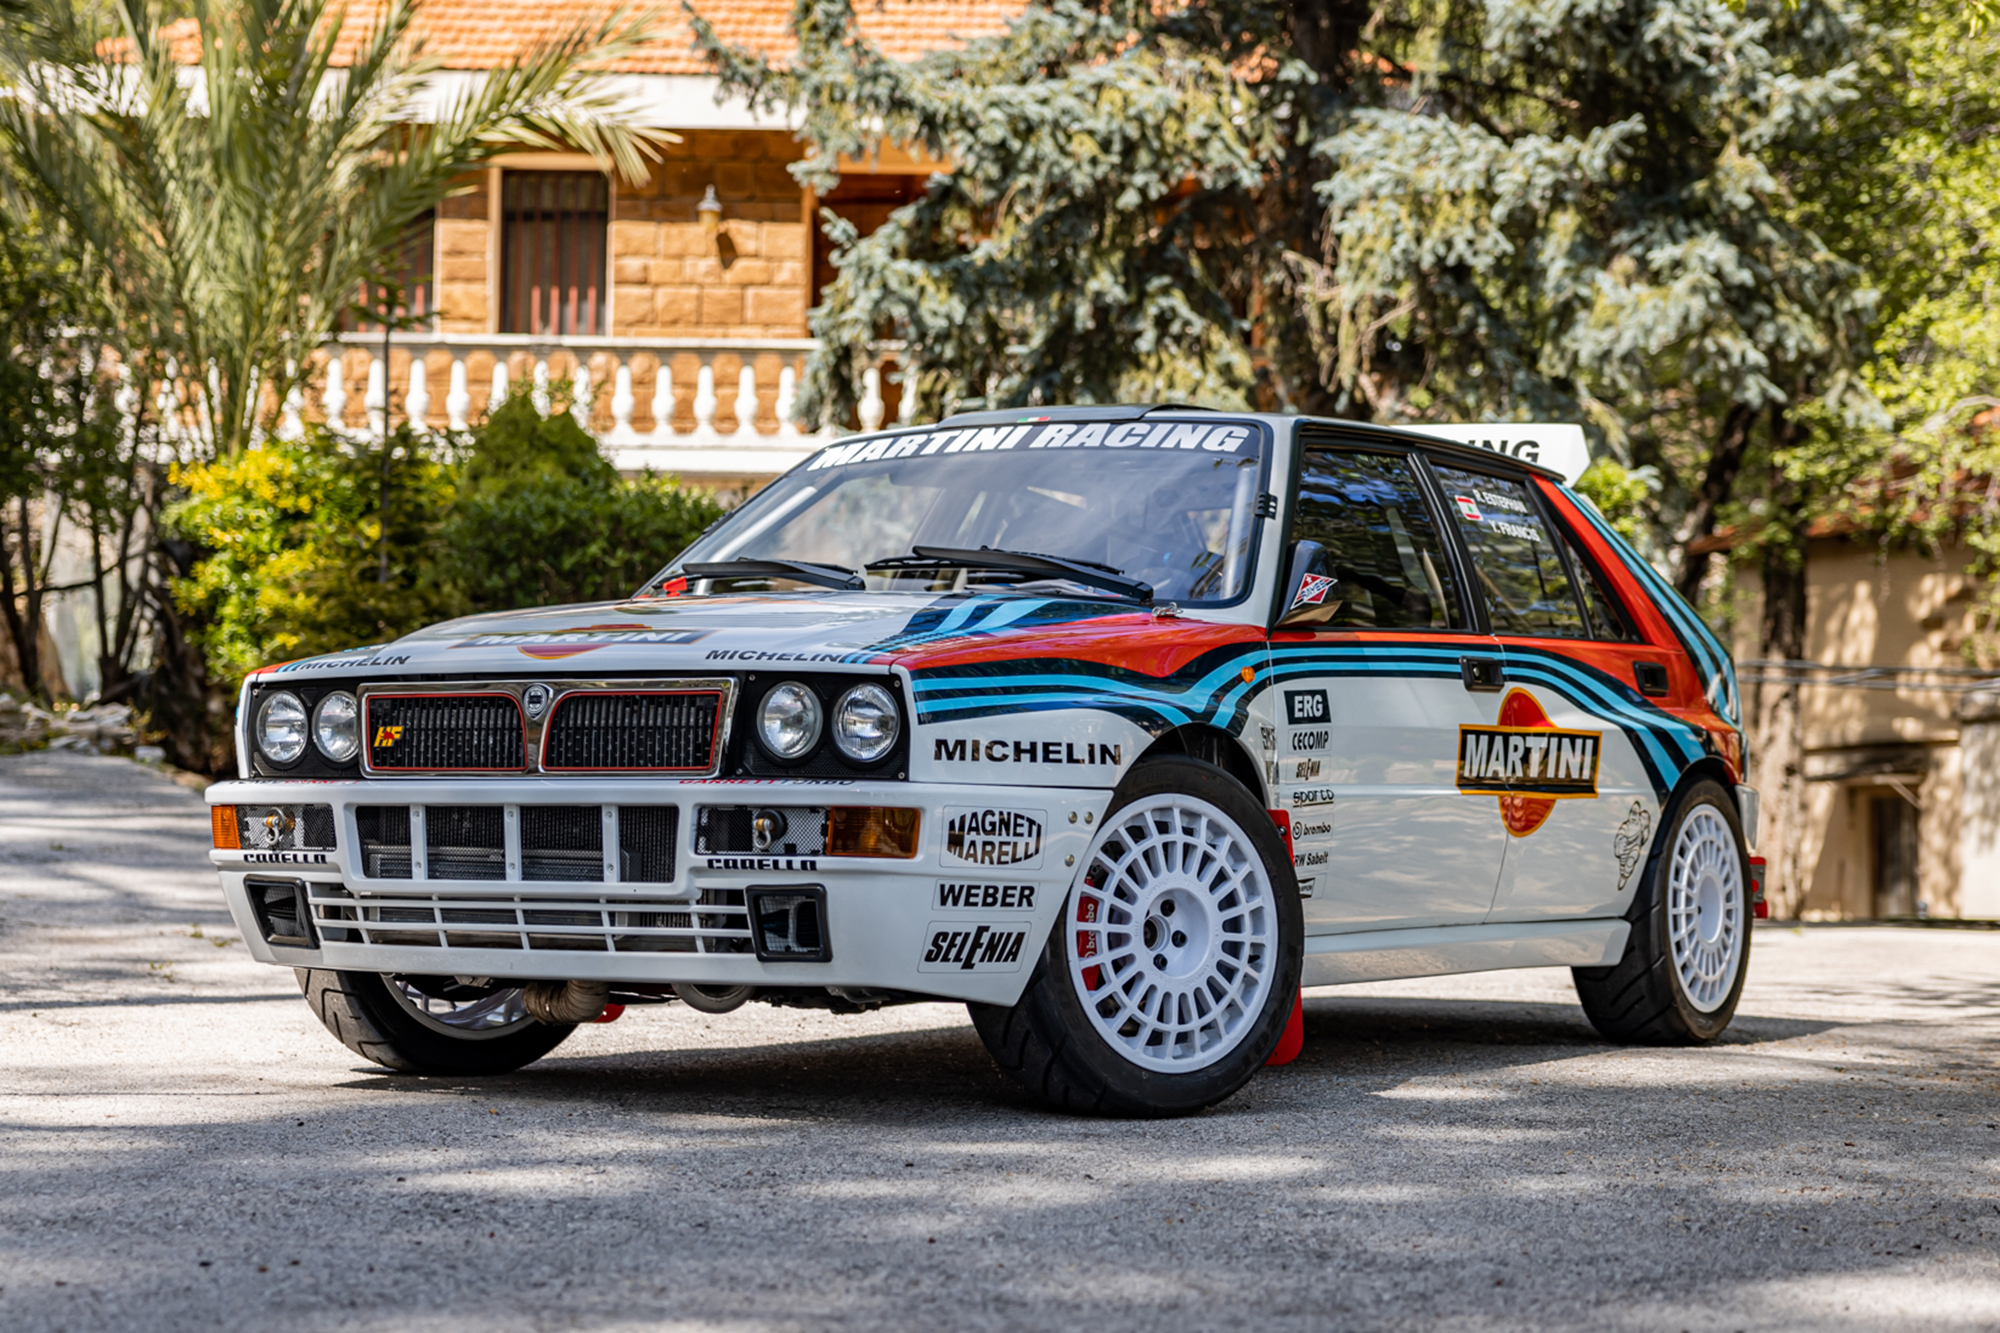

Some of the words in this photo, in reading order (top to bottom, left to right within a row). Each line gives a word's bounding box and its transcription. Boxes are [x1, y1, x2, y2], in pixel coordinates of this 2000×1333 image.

[806, 424, 1033, 471] MARTINI
[1029, 422, 1251, 453] RACING
[1482, 492, 1528, 513] ESTEPHAN
[1498, 522, 1541, 542] FRANCIS
[475, 631, 692, 645] MARTINI
[300, 655, 411, 670] MICHELIN
[705, 650, 845, 662] MICHELIN
[1294, 694, 1323, 718] ERG
[373, 725, 404, 747] HF
[1292, 730, 1329, 751] CECOMP
[934, 739, 1121, 765] MICHELIN
[1463, 734, 1594, 780] MARTINI
[1293, 790, 1334, 808] sparco
[948, 810, 1042, 838] MAGNETI
[1304, 821, 1332, 836] brembo
[946, 837, 1042, 865] MARELLI
[1306, 851, 1329, 866] Sabelt
[939, 884, 1035, 908] WEBER
[924, 925, 1026, 970] SELENIA
